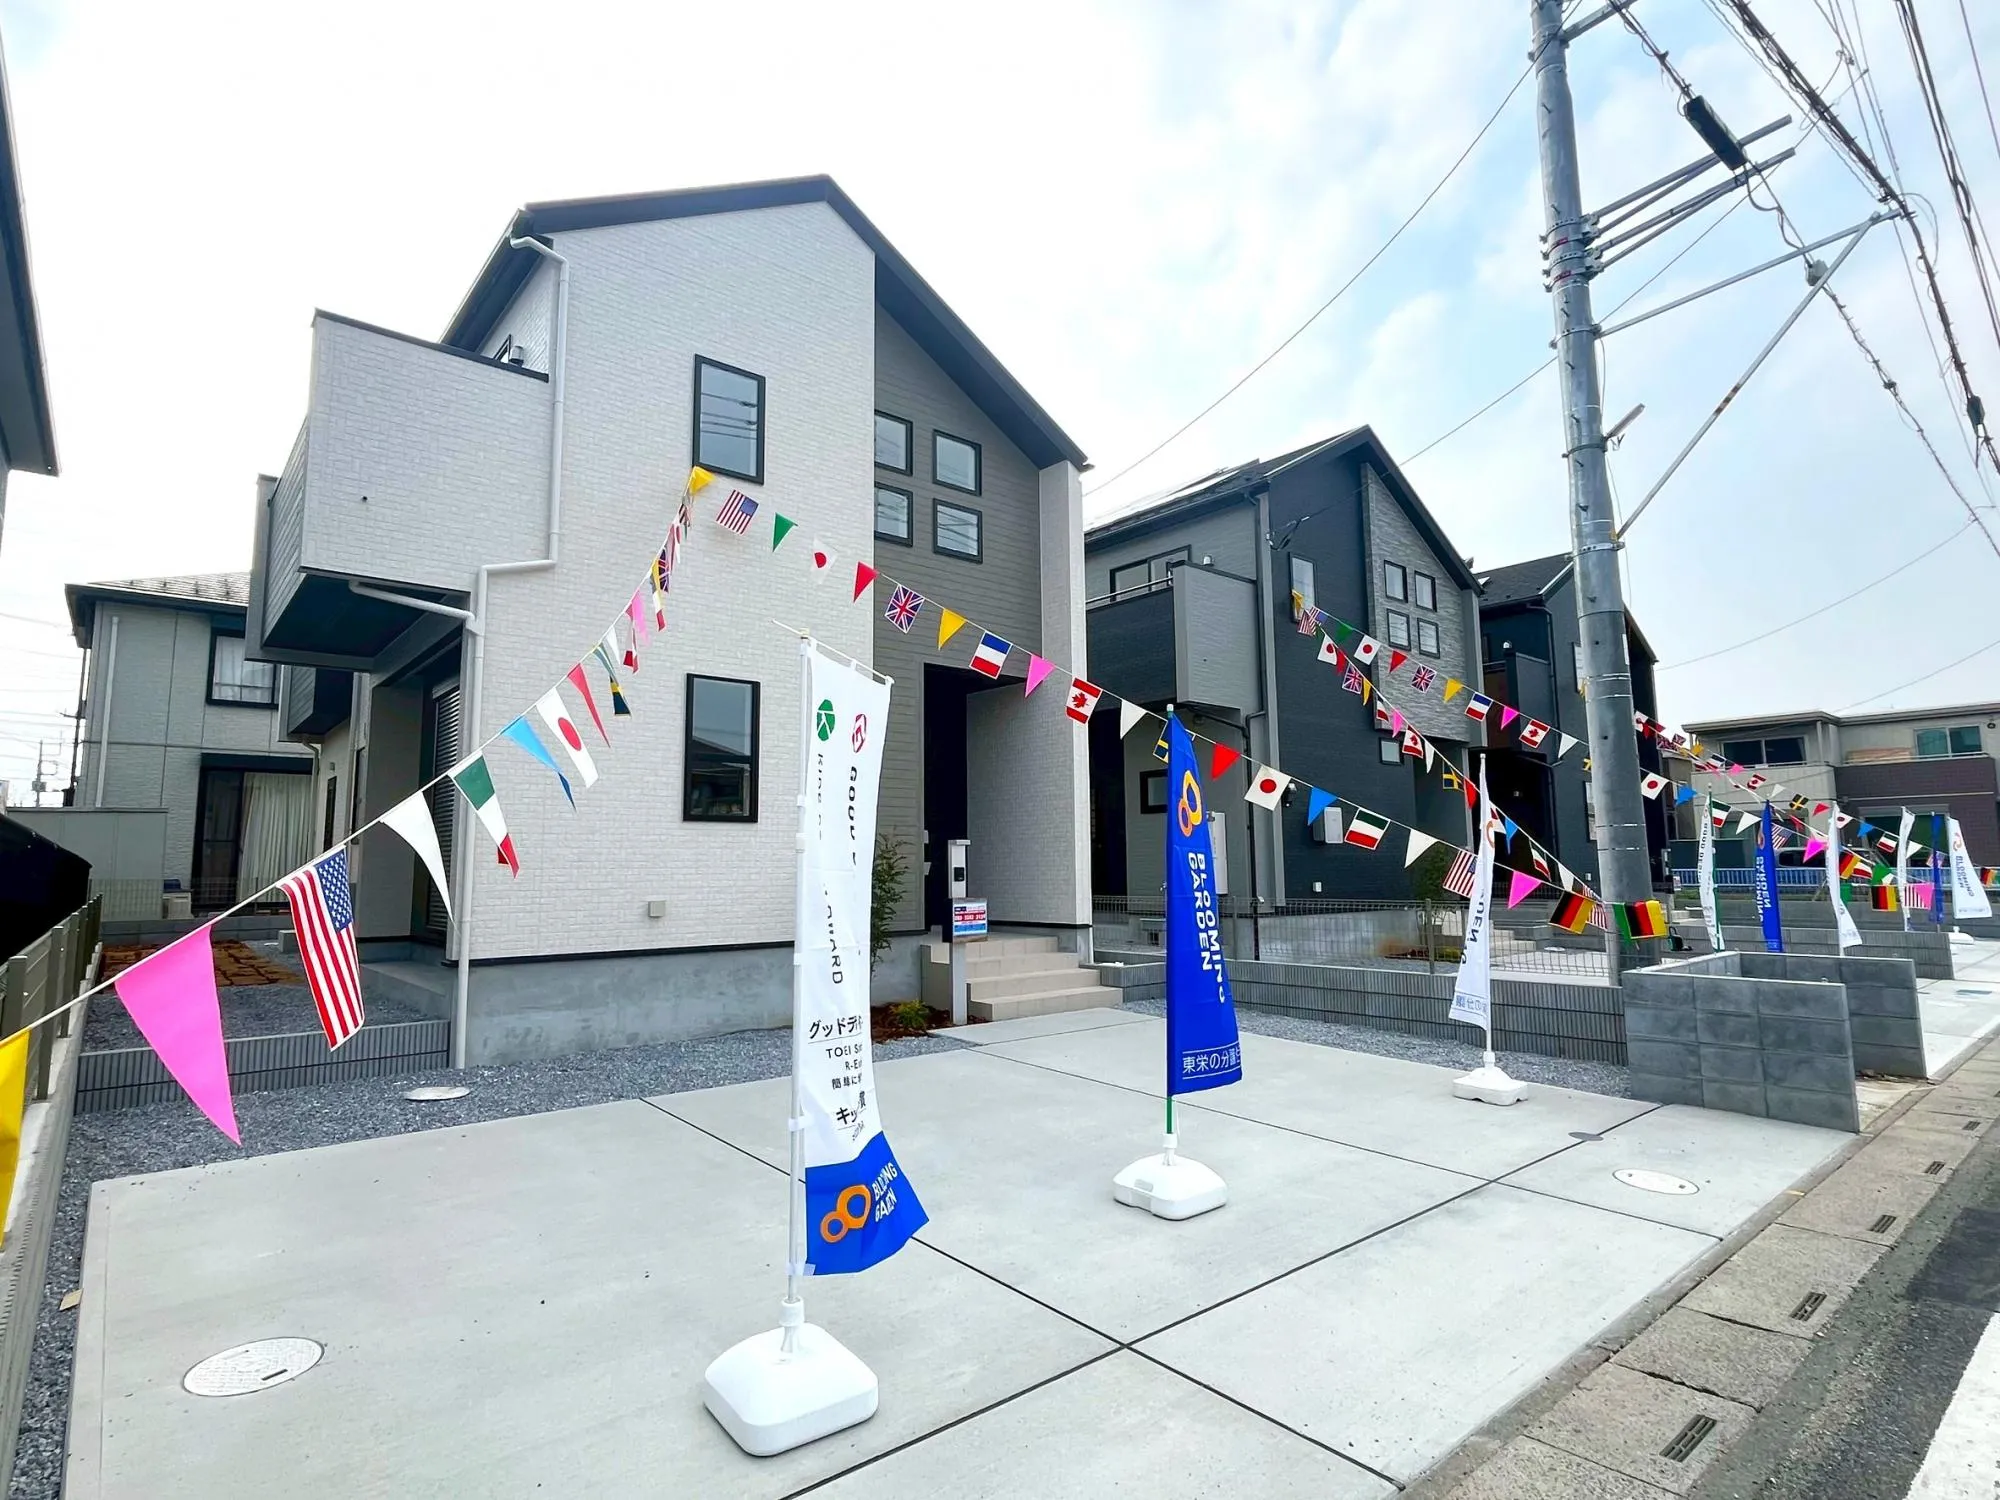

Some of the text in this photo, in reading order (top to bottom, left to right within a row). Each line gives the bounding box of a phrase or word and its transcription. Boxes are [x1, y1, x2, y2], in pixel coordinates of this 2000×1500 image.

[1188, 852, 1212, 971] GARDEN
[809, 1015, 863, 1039] グッドデ
[826, 1045, 852, 1059] TOEI
